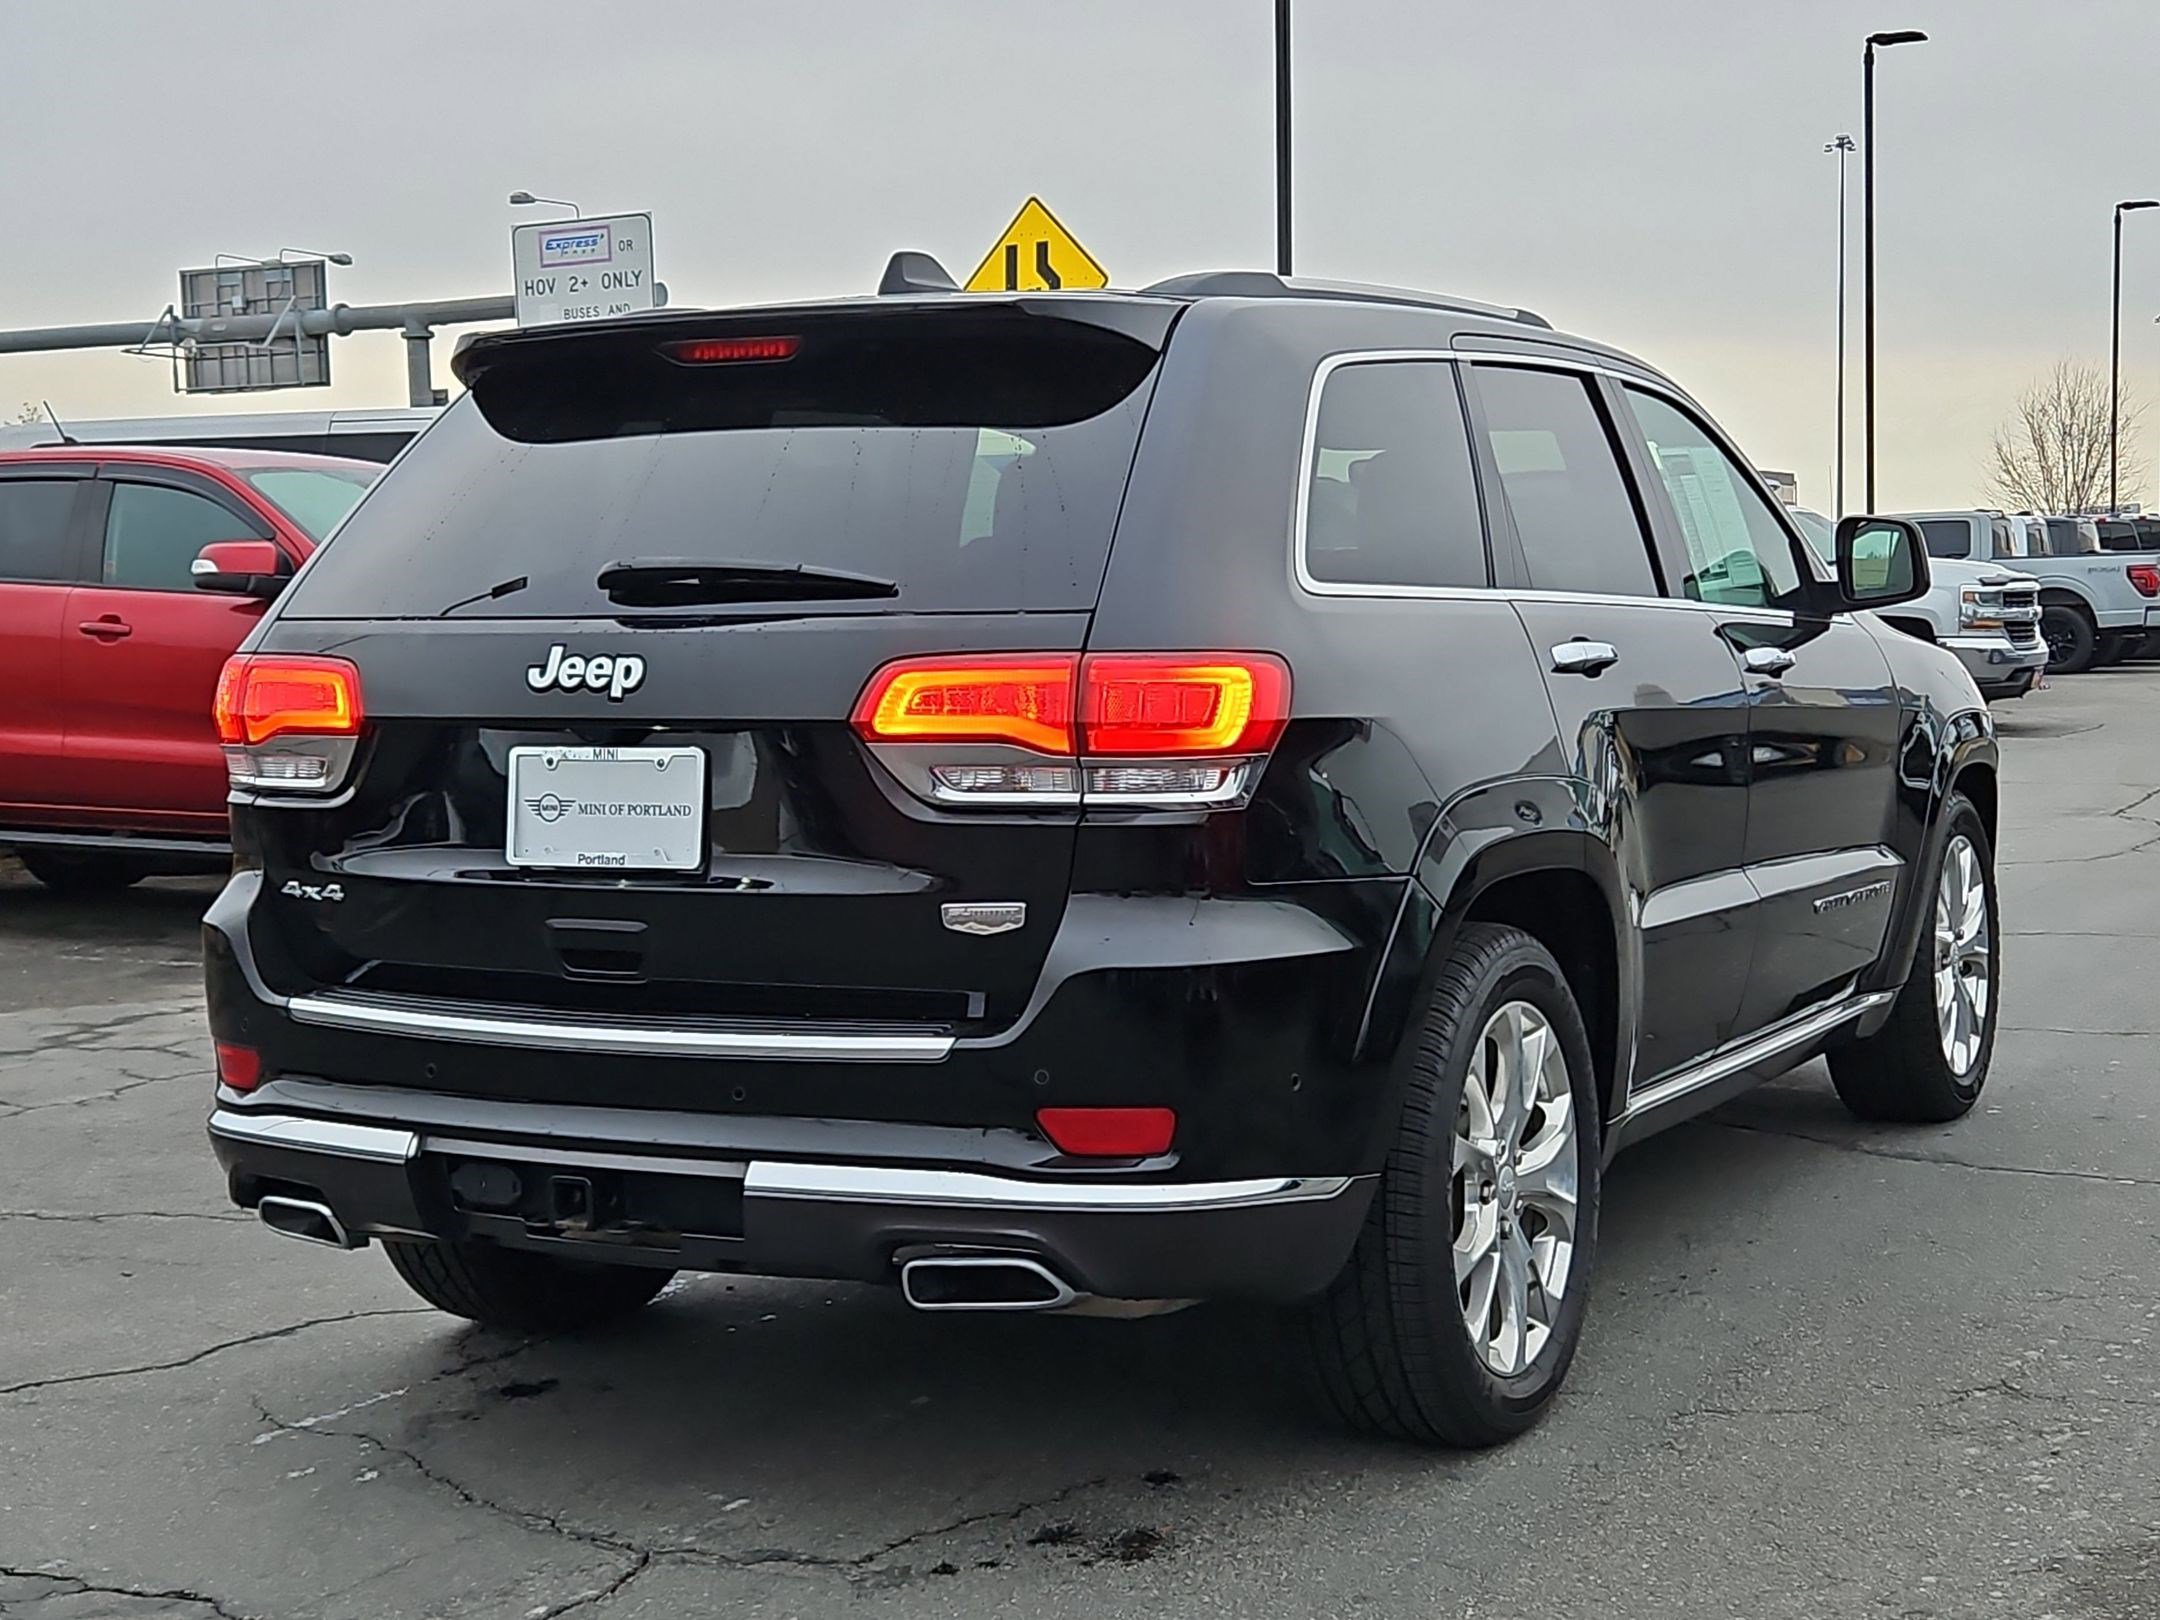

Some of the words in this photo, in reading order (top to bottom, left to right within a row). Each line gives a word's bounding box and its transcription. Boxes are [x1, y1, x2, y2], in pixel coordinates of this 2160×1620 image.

[545, 234, 602, 256] Express
[618, 240, 633, 251] OR
[525, 278, 556, 295] HOV
[569, 276, 588, 292] 2+
[602, 270, 642, 289] ONLY
[564, 306, 600, 320] BUSES
[608, 303, 631, 316] AND
[526, 643, 645, 699] Jeep
[593, 748, 619, 760] MINI
[578, 804, 606, 815] MINI
[609, 804, 625, 815] OF
[628, 804, 691, 816] PORTLAND
[578, 854, 625, 865] Portland
